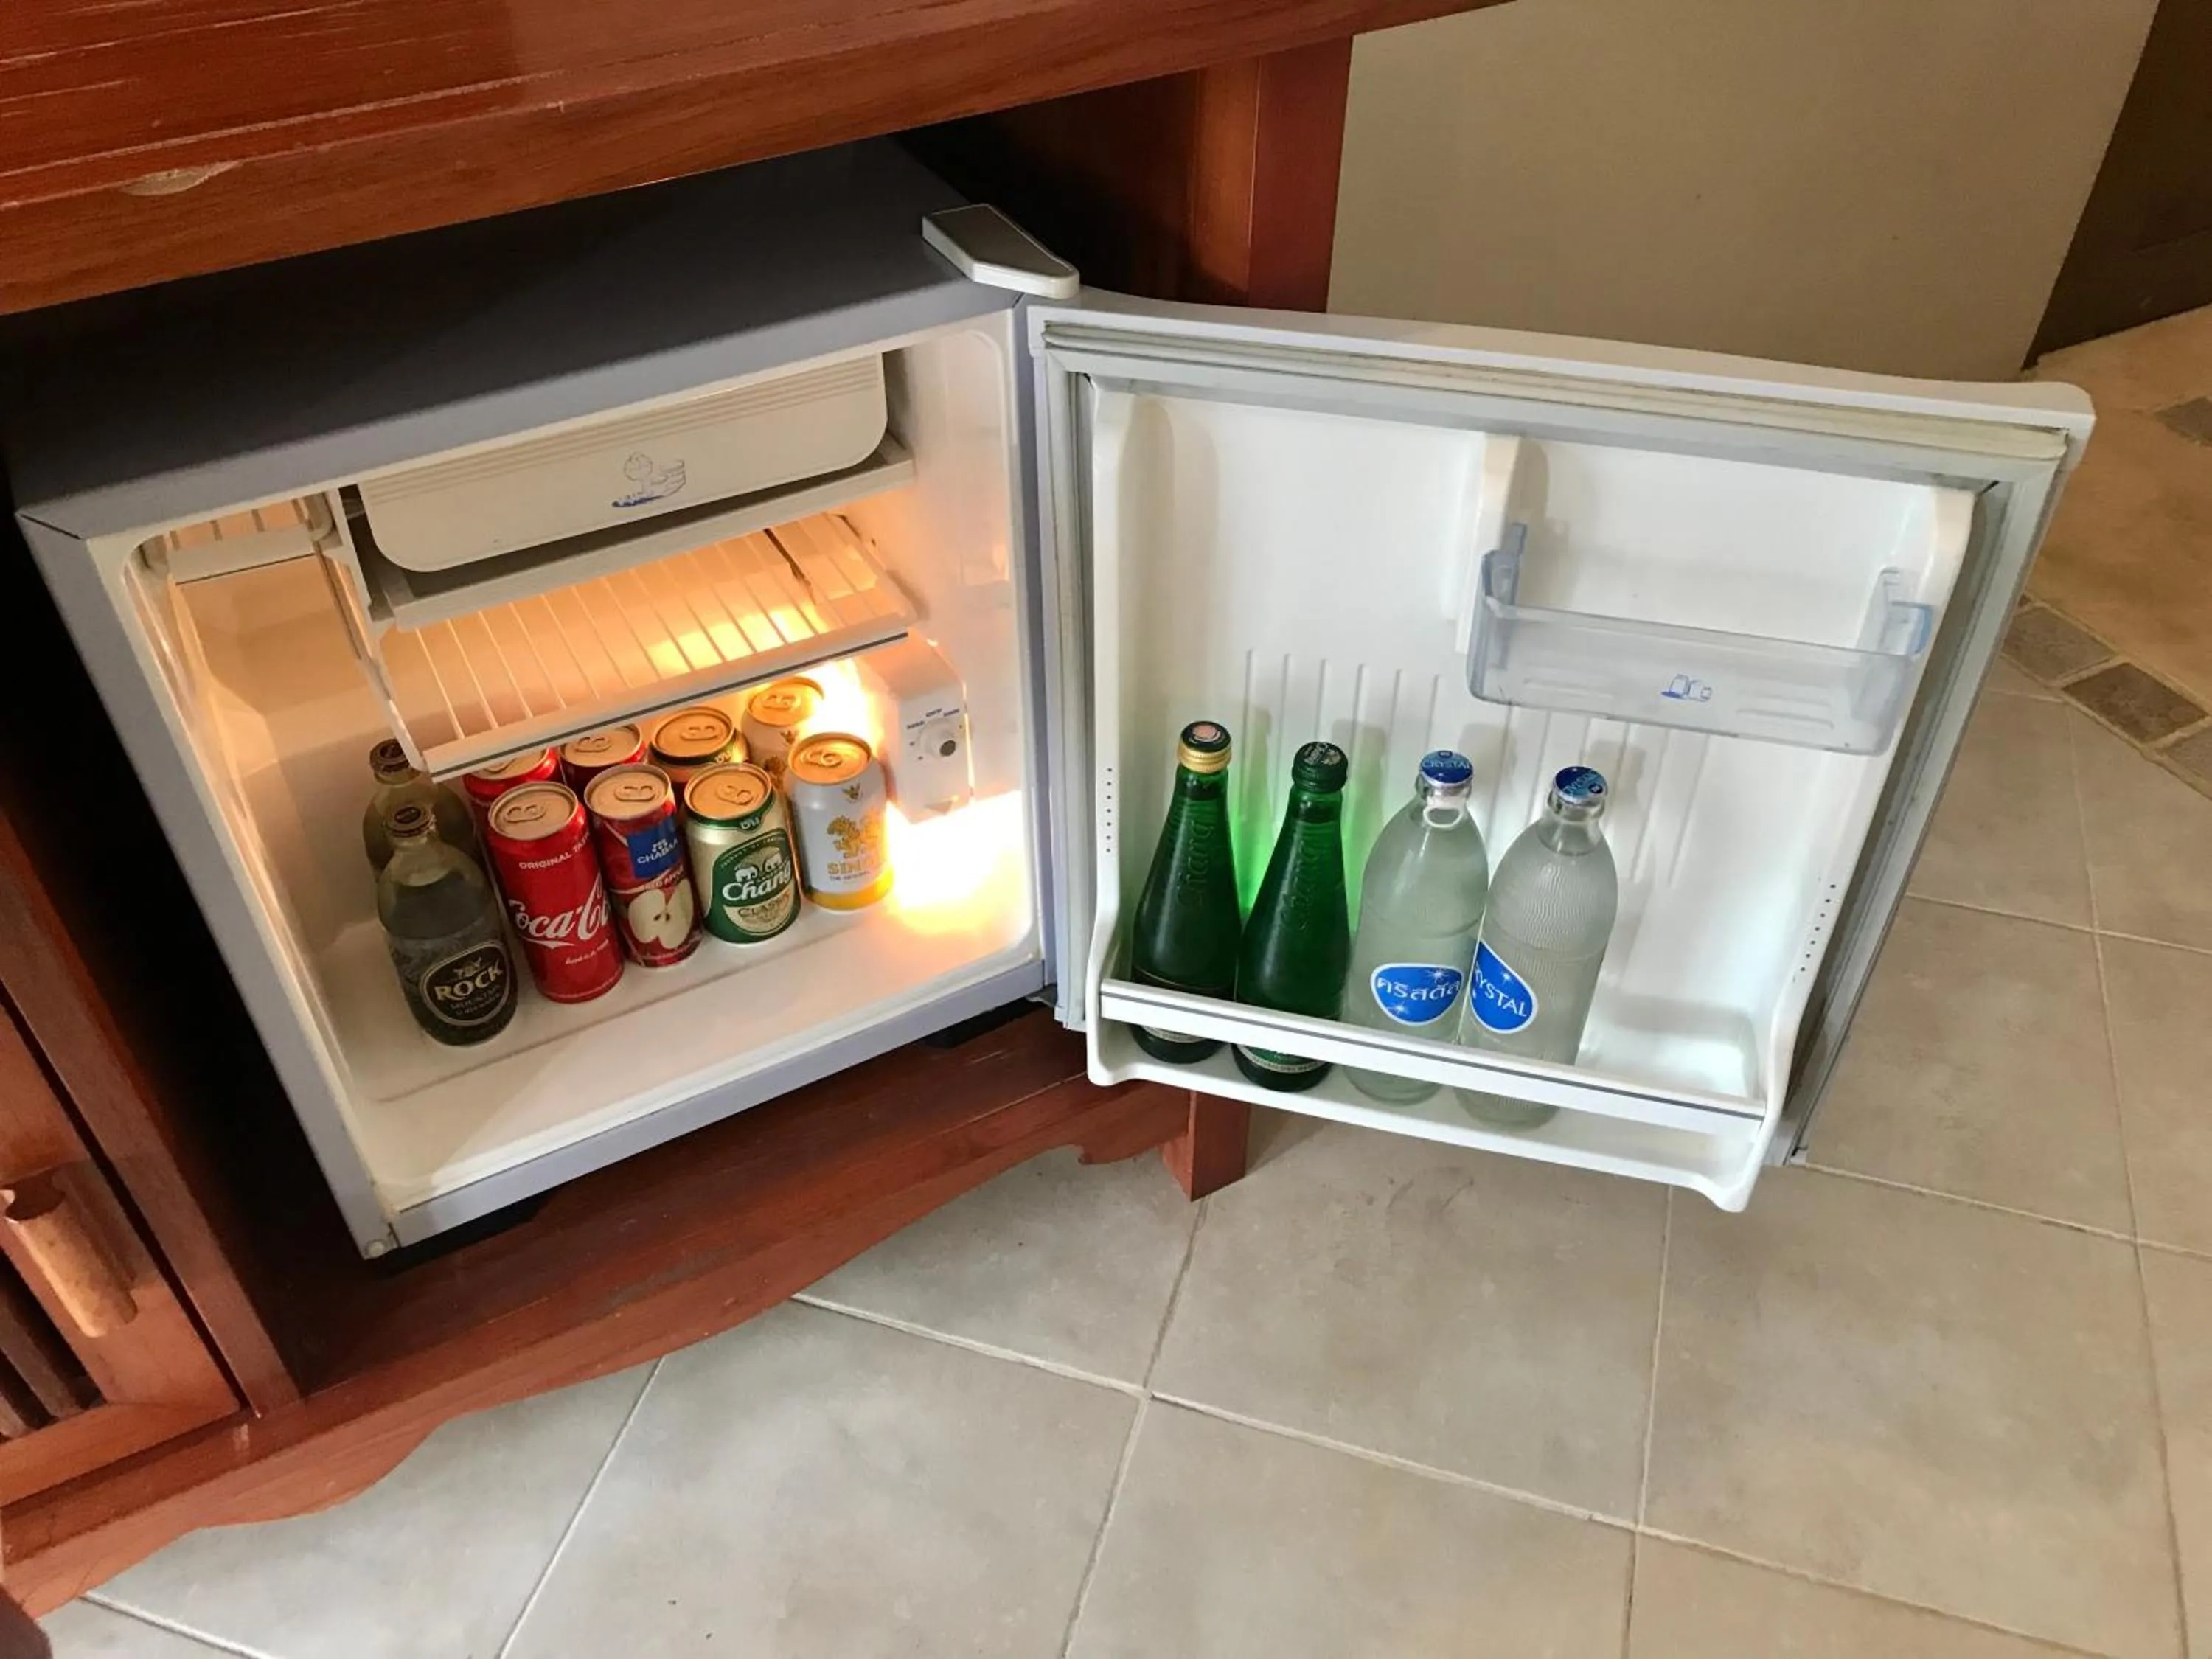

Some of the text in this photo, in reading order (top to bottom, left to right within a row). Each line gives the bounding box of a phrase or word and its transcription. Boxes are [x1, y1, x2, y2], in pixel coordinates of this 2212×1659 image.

[519, 851, 572, 869] ORIGINAL
[722, 858, 791, 901] Chang
[434, 959, 502, 1001] ROCK
